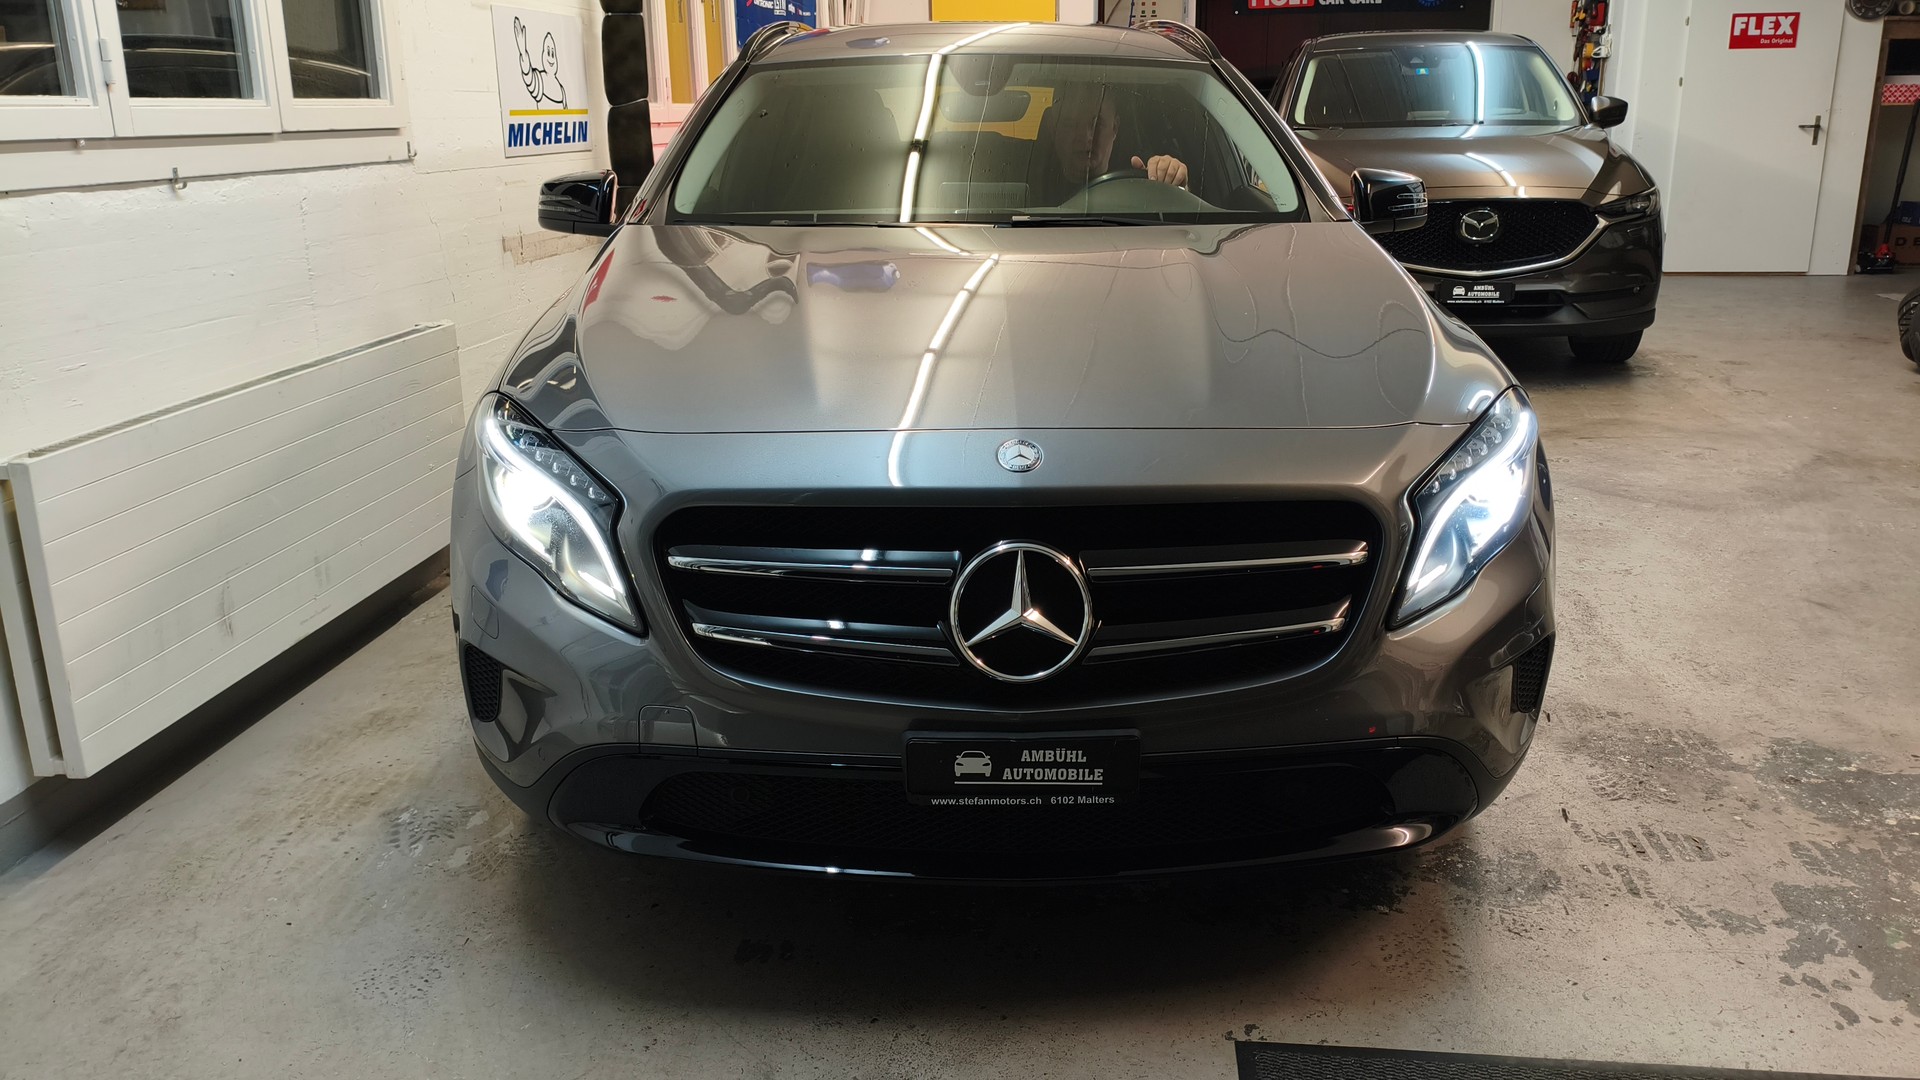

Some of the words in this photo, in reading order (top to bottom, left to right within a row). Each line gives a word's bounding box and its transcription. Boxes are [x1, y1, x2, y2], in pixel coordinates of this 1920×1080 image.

[1733, 15, 1796, 36] FLEX
[1771, 37, 1794, 45] Original
[508, 121, 588, 148] MICHELIN
[1020, 747, 1087, 763] AMBÜHL
[1002, 767, 1104, 781] AUTOMOBILE
[931, 796, 1042, 805] www.stefanmotors.ch
[1050, 796, 1075, 805] 6102
[1077, 795, 1115, 804] Malters
